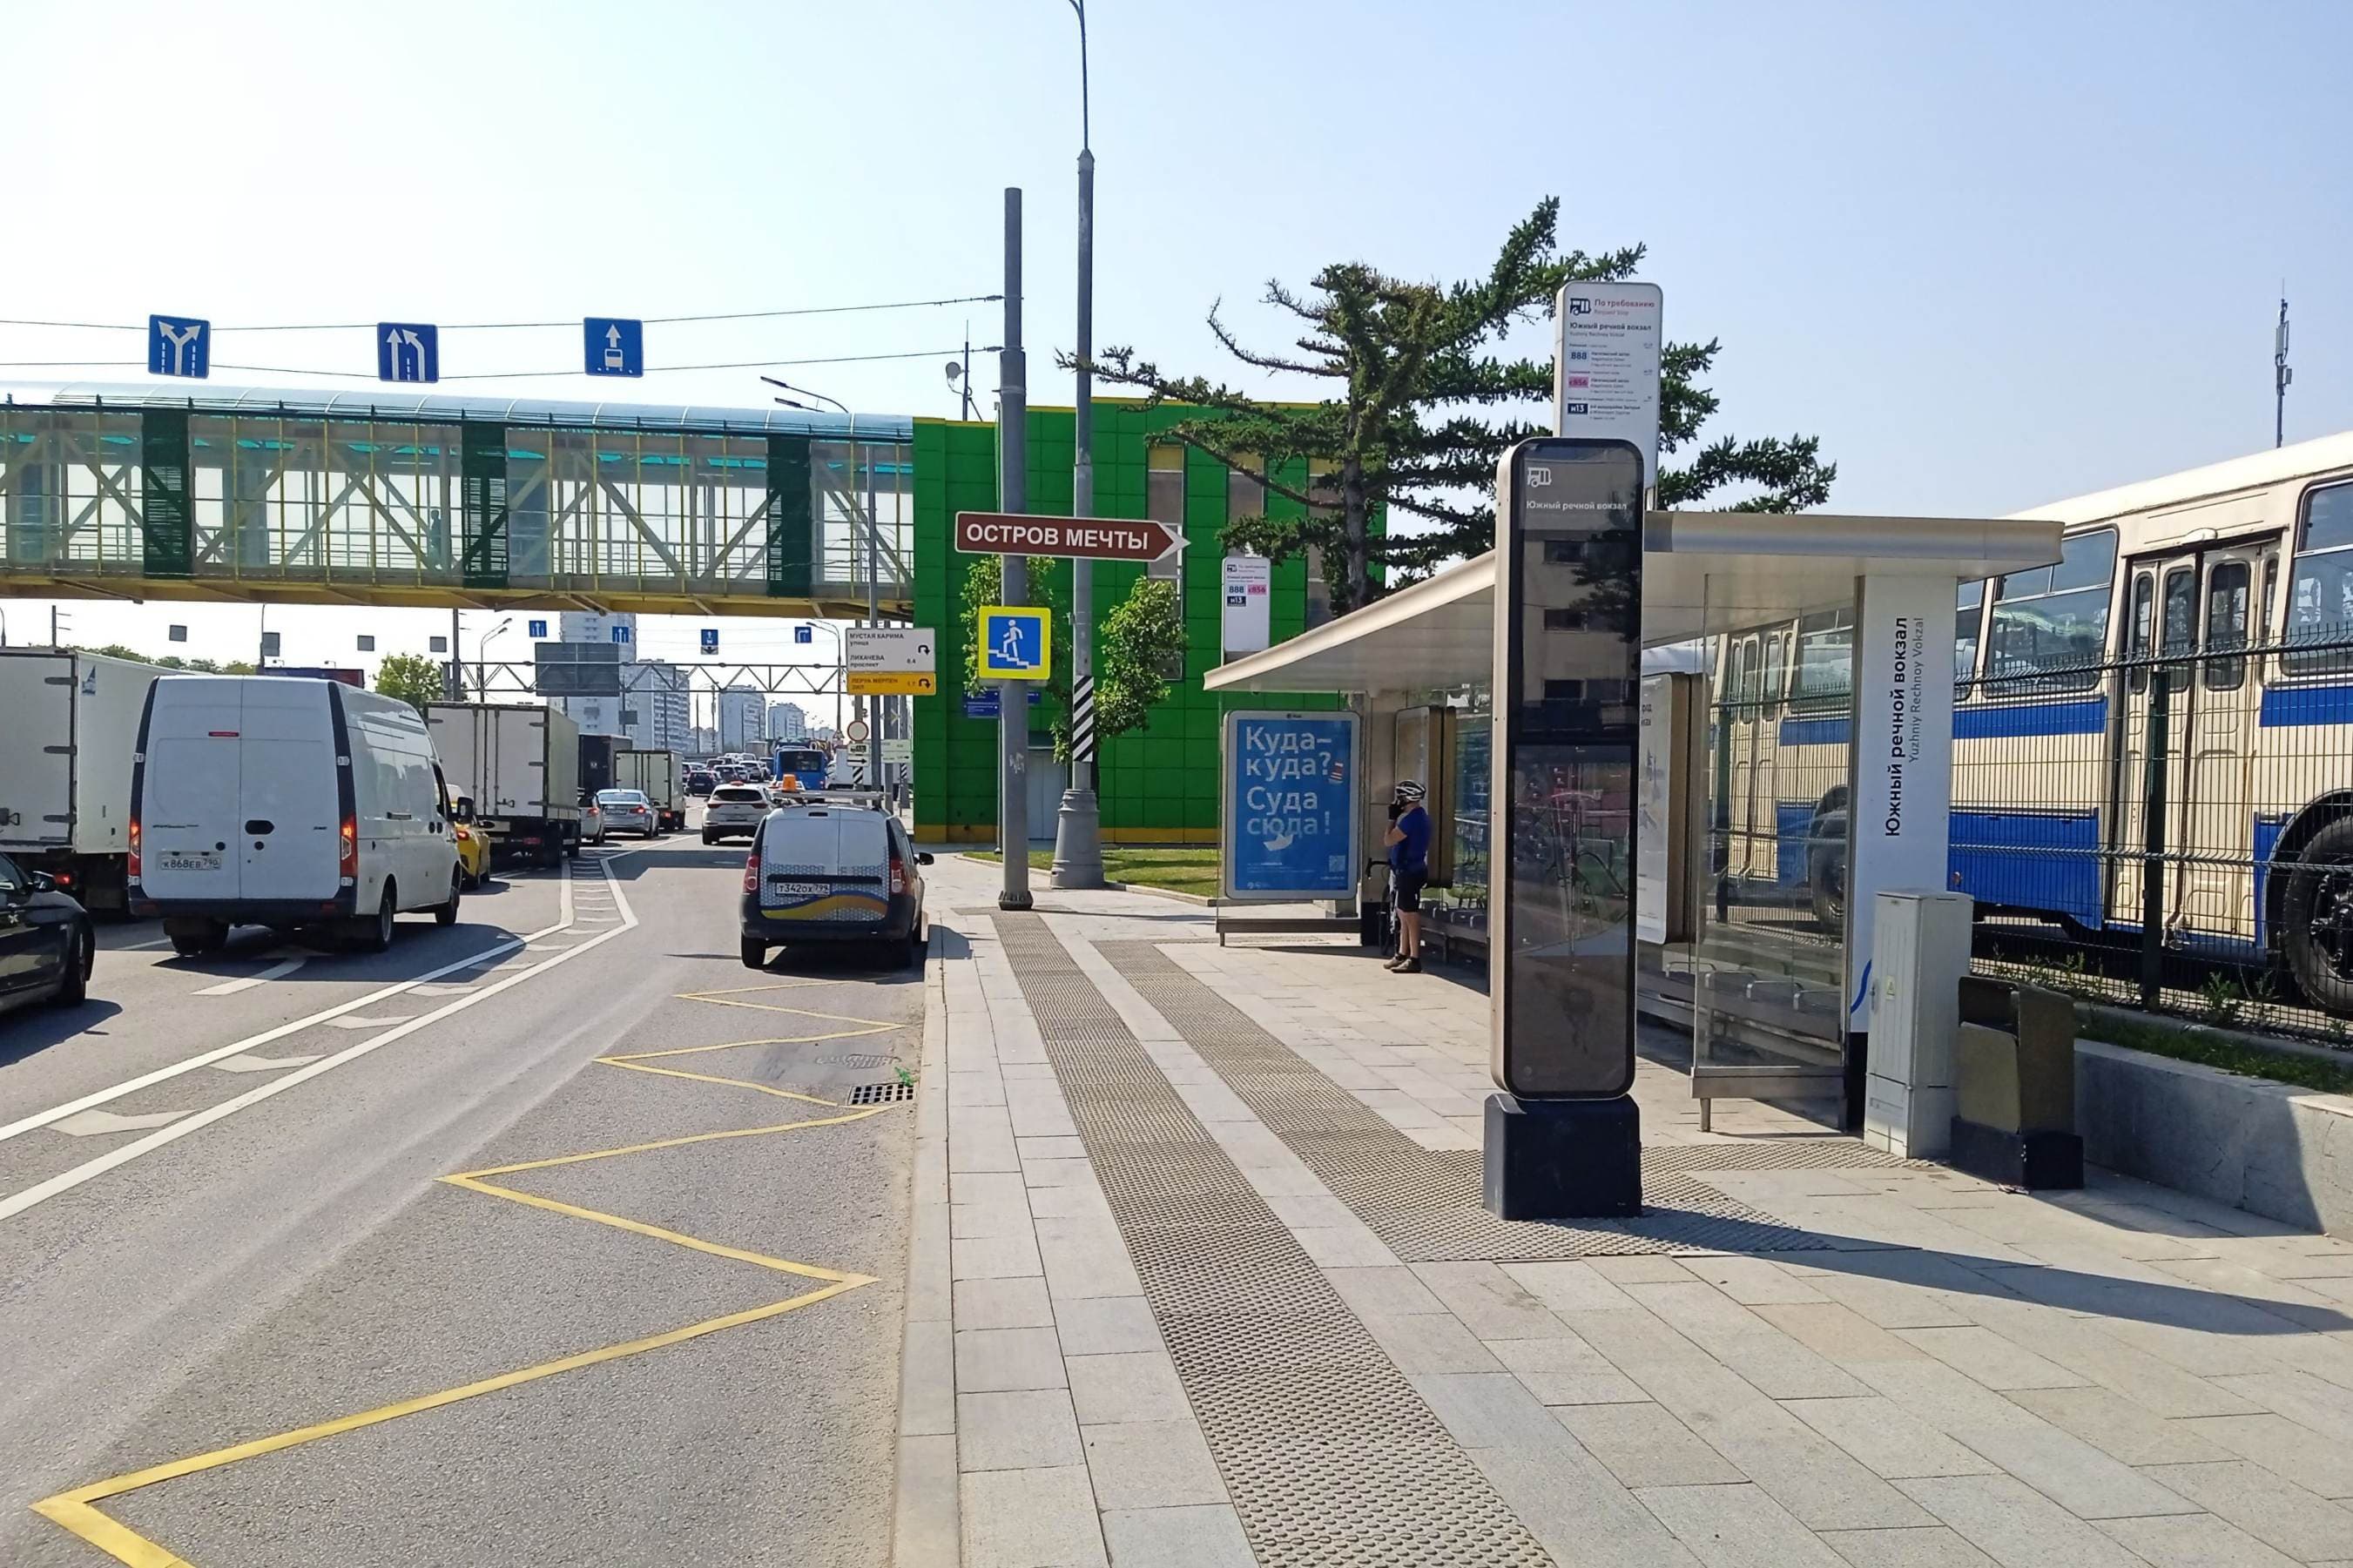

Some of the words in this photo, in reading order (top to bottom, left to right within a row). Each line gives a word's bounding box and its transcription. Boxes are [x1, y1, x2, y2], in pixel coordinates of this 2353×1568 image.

[1526, 500, 1561, 509] Южный
[1562, 501, 1595, 511] речной
[966, 522, 1060, 547] ОСТРОВ
[1065, 528, 1150, 551] МЕЧТЫ
[1893, 617, 1907, 683] вокзал
[1912, 617, 1924, 656] Vokzal
[1910, 659, 1925, 712] Rechnoy
[1889, 688, 1906, 758] речной
[1908, 717, 1924, 763] Yuzhniy
[1246, 751, 1332, 782] куда?
[1246, 786, 1318, 816] Суда
[1884, 764, 1903, 837] Южный
